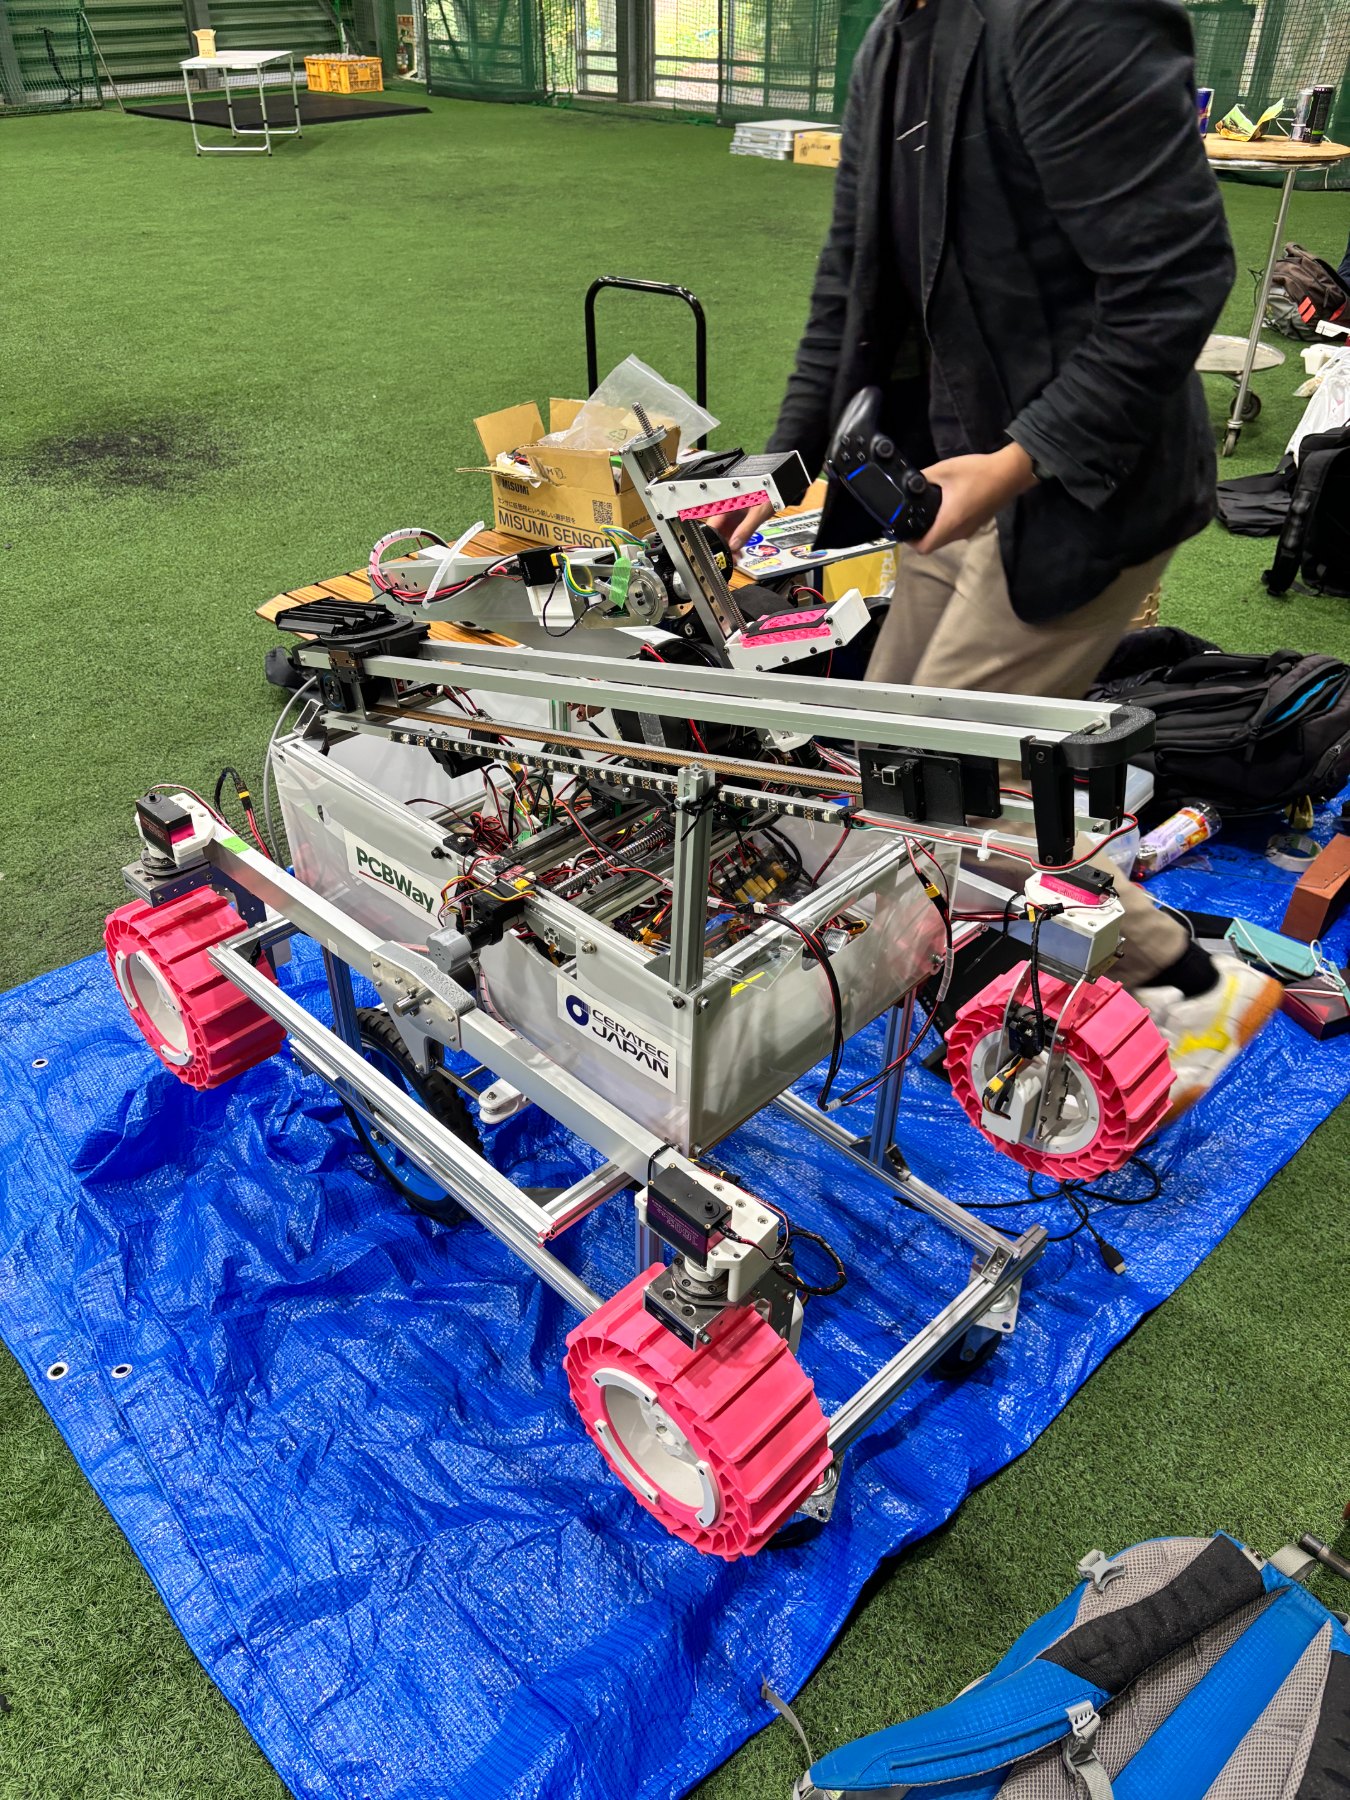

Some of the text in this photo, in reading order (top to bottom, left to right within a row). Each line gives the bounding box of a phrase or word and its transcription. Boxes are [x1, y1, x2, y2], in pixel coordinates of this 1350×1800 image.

[498, 510, 549, 538] MISUMI
[356, 846, 434, 914] PCBWay
[592, 1009, 669, 1064] CERATEC
[592, 1026, 669, 1080] JAPAN
